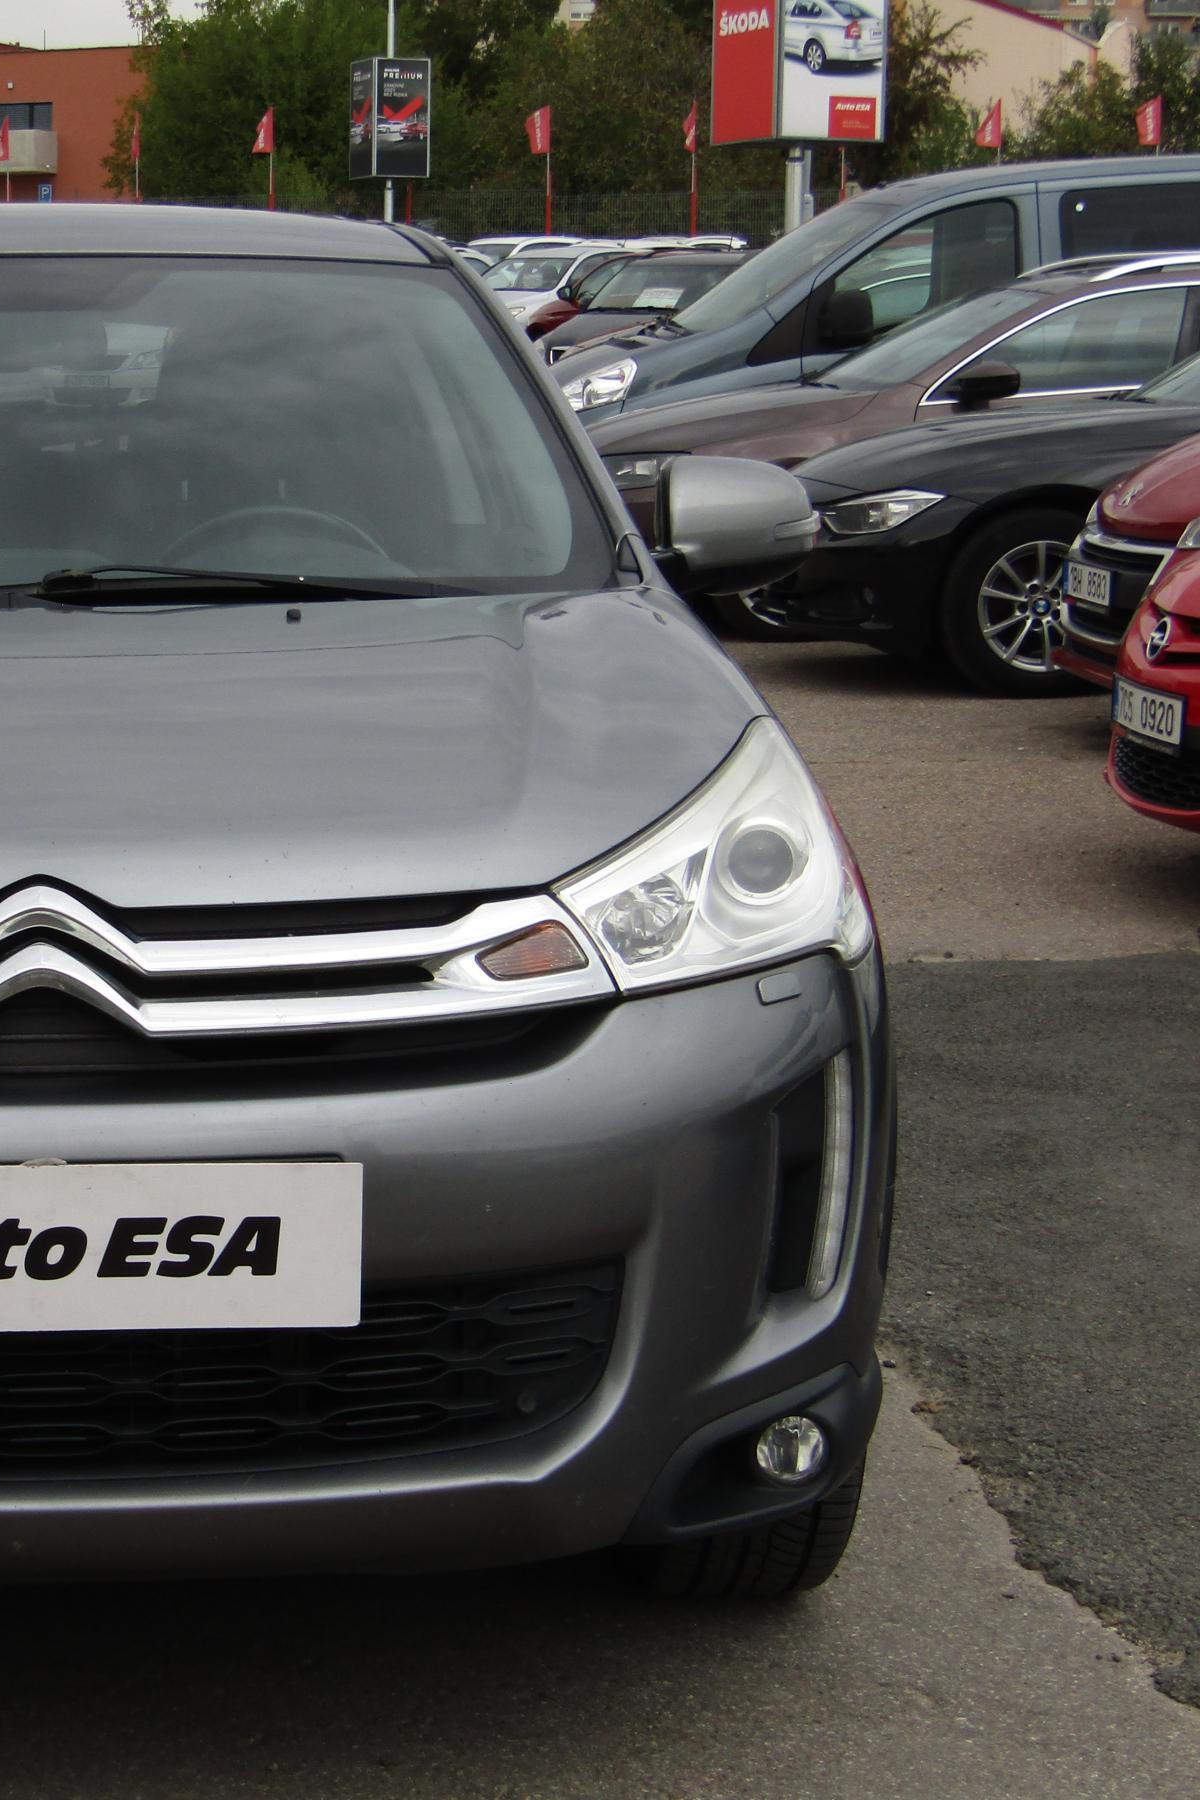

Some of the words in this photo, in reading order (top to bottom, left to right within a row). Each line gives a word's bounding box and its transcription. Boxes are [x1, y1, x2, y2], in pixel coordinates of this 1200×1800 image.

[719, 8, 769, 37] ŠKODA
[41, 186, 49, 198] P
[1087, 571, 1106, 600] 8583
[1141, 696, 1174, 736] 0920
[96, 1215, 281, 1278] ESA
